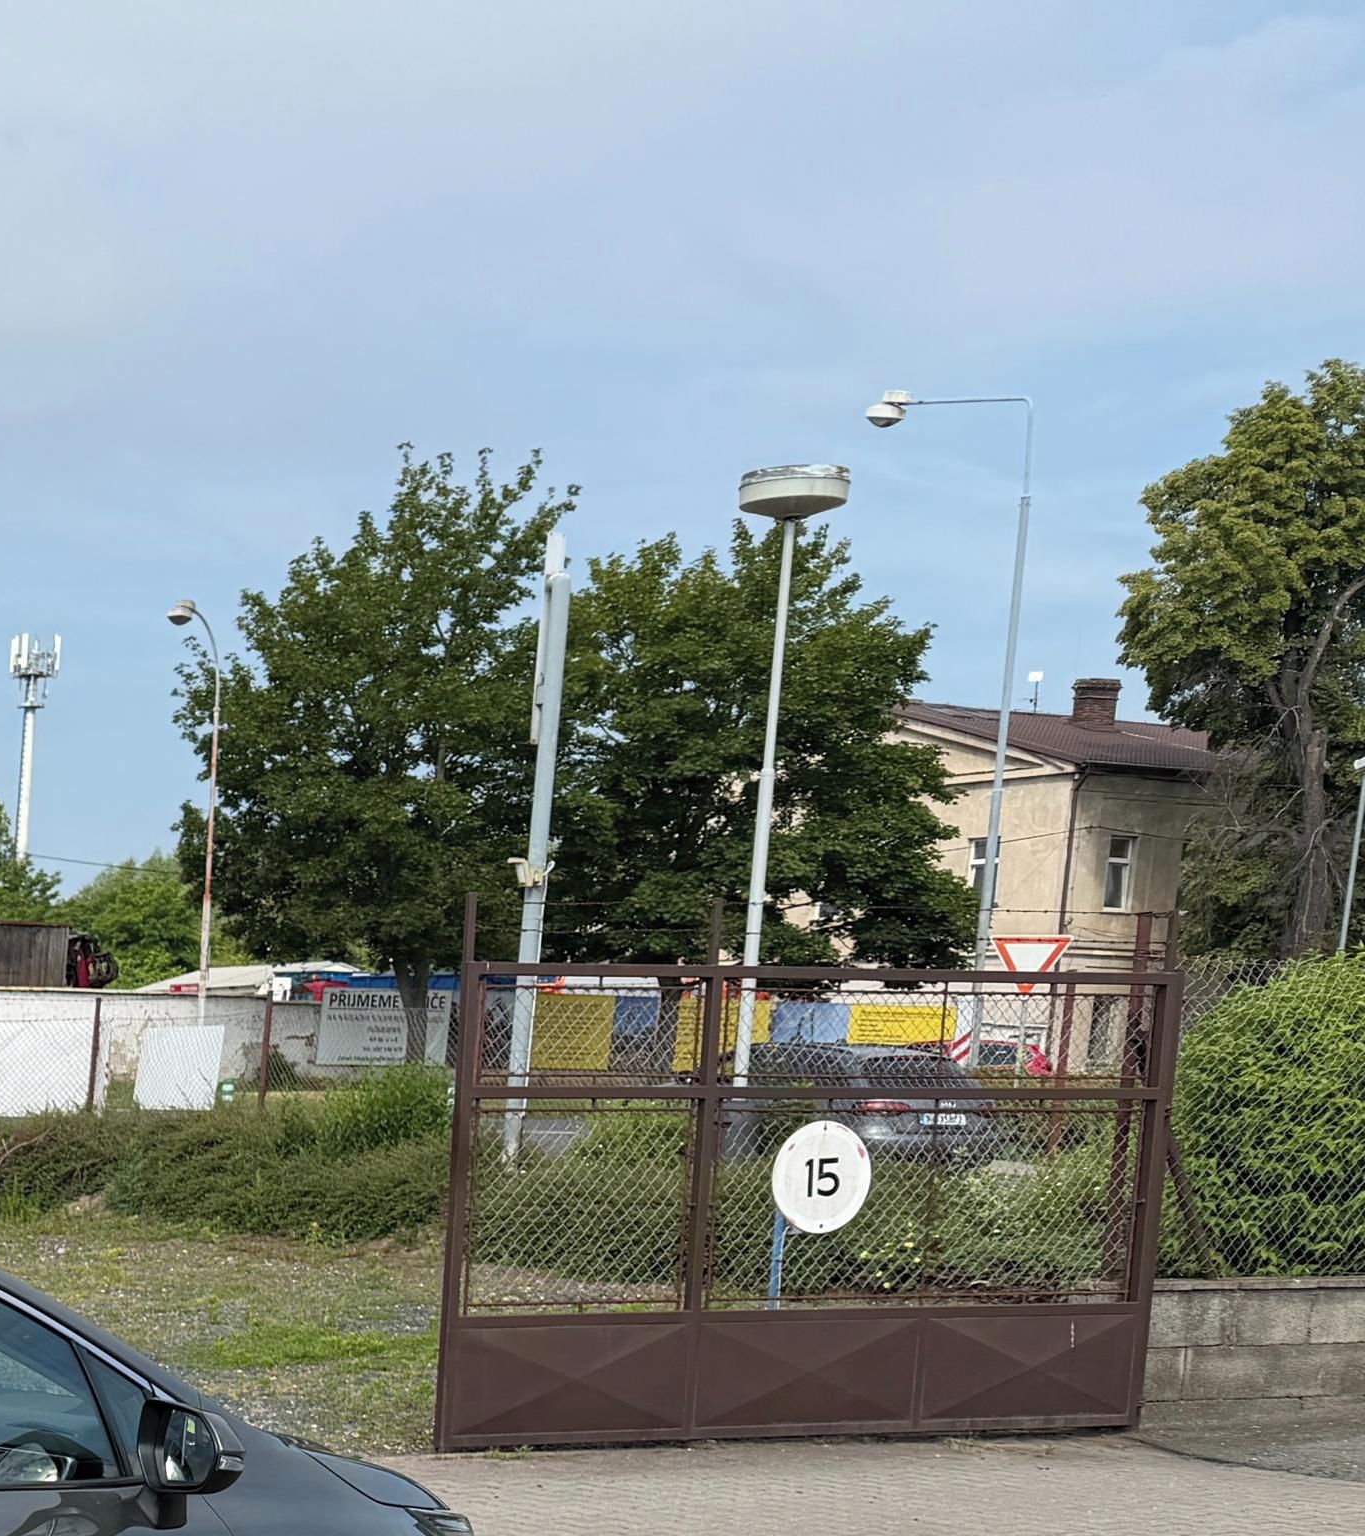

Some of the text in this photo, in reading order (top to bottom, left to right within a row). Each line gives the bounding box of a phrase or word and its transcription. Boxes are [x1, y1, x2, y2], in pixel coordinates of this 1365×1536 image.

[329, 989, 446, 1010] PŘIJMEME IČE
[805, 1157, 840, 1197] 15
